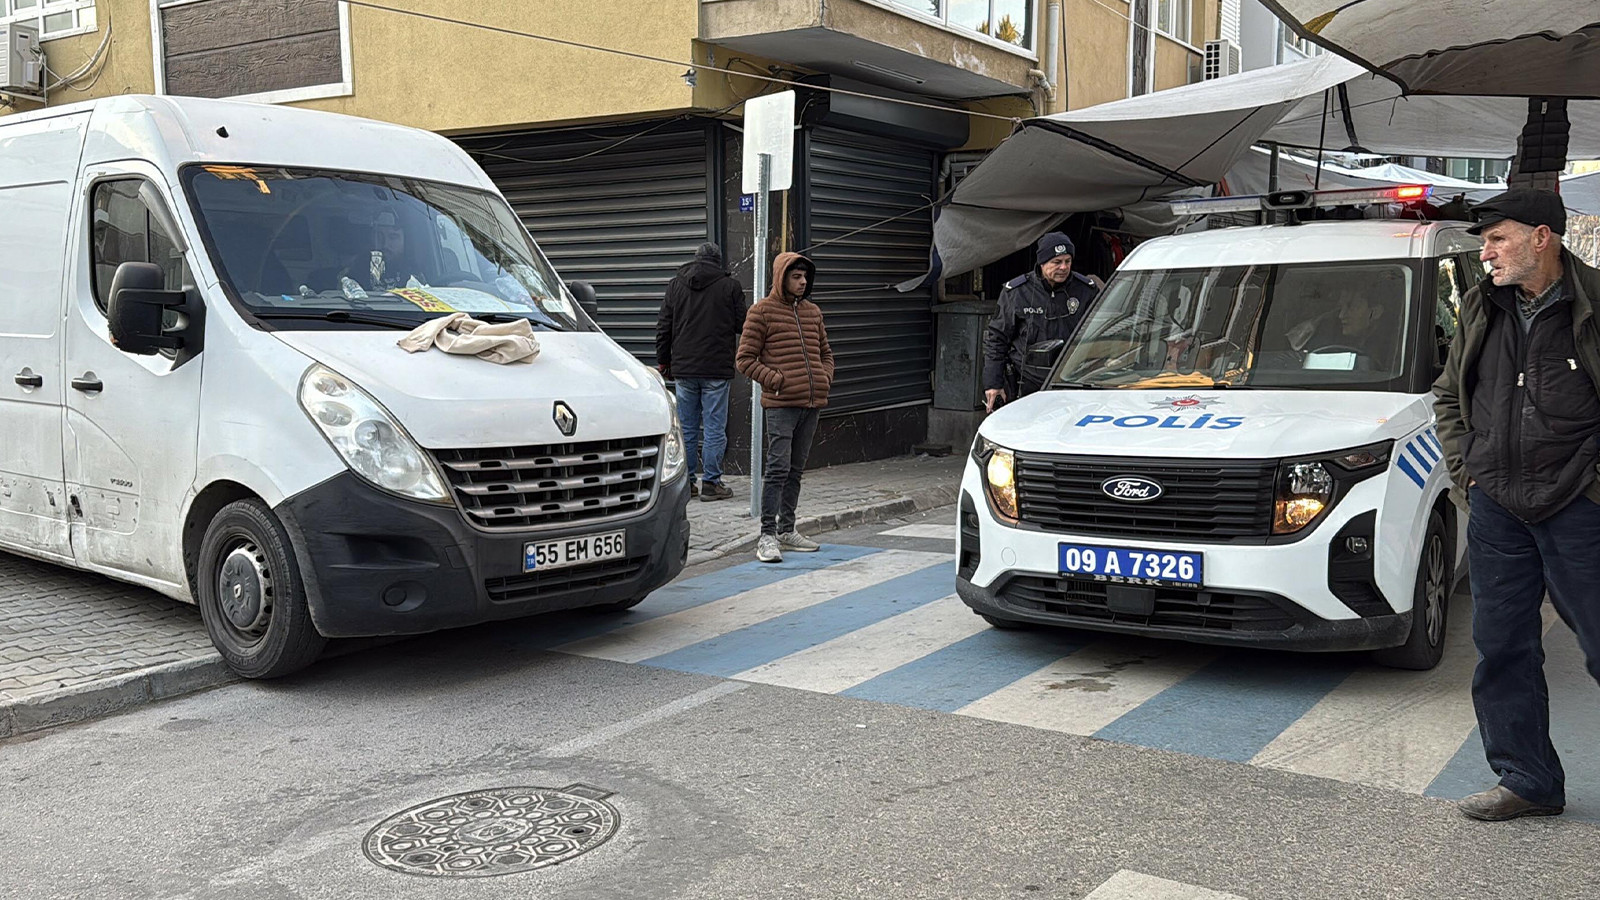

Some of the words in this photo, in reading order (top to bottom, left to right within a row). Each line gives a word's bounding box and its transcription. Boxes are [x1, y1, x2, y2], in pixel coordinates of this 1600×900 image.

[1074, 413, 1246, 430] POLİS
[1113, 481, 1150, 498] Ford
[536, 544, 558, 565] 55
[565, 540, 588, 562] EM
[593, 534, 623, 557] 656
[1066, 548, 1096, 572] 09
[1104, 551, 1121, 574] A
[1129, 552, 1194, 580] 7326
[1094, 574, 1163, 586] BERK
